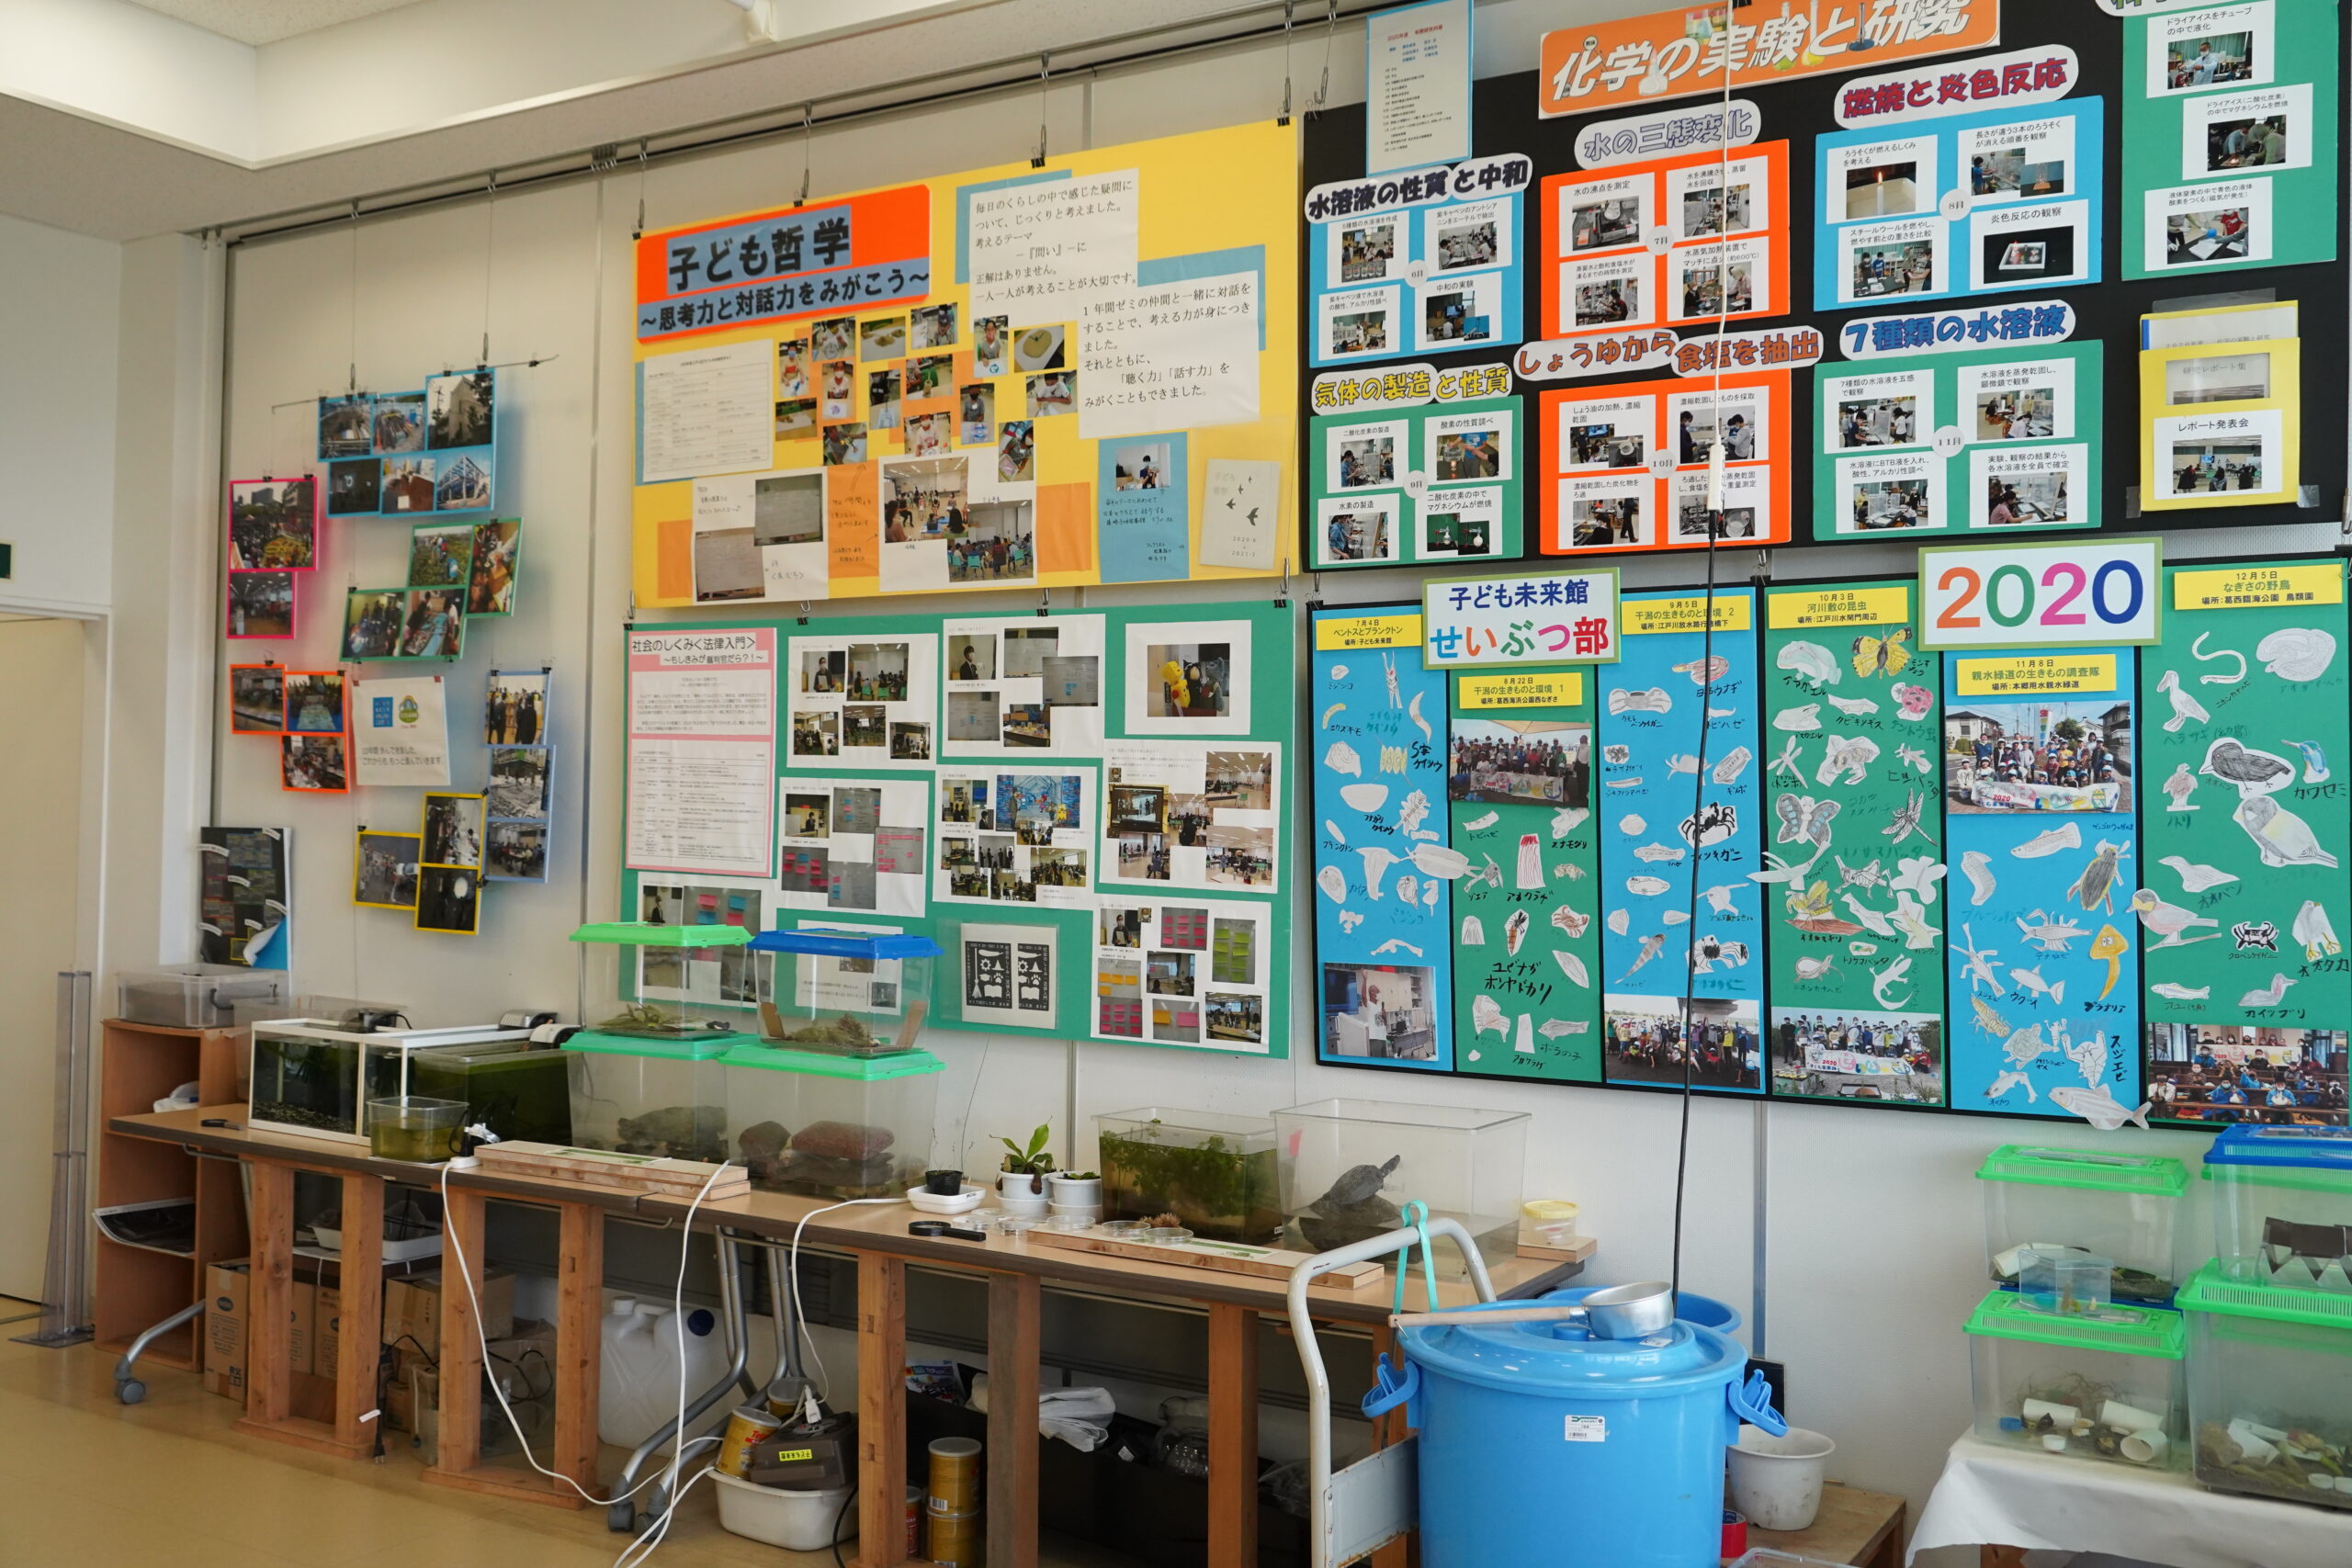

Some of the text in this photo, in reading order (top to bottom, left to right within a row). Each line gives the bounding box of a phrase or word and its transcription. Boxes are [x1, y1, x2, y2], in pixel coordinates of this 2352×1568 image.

[2166, 7, 2253, 26] ドライアイスをチューブ
[2166, 23, 2211, 37] の中で液化
[1552, 0, 1972, 101] 化学の実験と研究
[1842, 57, 2068, 119] 燃焼と炎色反応
[1584, 109, 1753, 162] 水の三態変化
[1844, 141, 1916, 157] ろうそくが燃えるしくみ
[1843, 156, 1871, 167] を考える
[1308, 159, 1530, 220] 水溶液の性質と中和
[1574, 180, 1631, 197] 水の沸点を測定
[975, 181, 1133, 214] 毎日のくらしの中で感じた疑問に
[975, 200, 1122, 230] ついて、じっくりと考えました。
[1991, 207, 2063, 224] 炎色反応の観察
[975, 231, 1034, 250] 考えるテーマ
[668, 216, 850, 291] 子ども哲学
[975, 266, 1057, 286] 正解はありません。
[975, 272, 1136, 301] 一人一人が考えることが大切です。
[1436, 280, 1475, 291] 中和の実験
[1083, 302, 1250, 335] することで、考える力が身につき
[1844, 304, 2067, 354] 7種類の水溶液
[1083, 339, 1119, 353] ました。
[1518, 330, 1819, 375] しょうゆから食塩を抽出
[1084, 355, 1150, 371] それとともに、
[1314, 367, 1510, 408] 気体の製造と性質
[1839, 374, 1915, 389] 7種類の水溶液を五感
[1980, 377, 2030, 389] 顕微鏡で観察
[1085, 384, 1207, 408] みがくこともできました。
[1842, 387, 1864, 397] で観察
[1440, 417, 1495, 430] 酸素の性質調べ
[2178, 417, 2249, 432] レポート発表会
[1343, 426, 1390, 437] 二酸化炭素の製造
[1427, 491, 1487, 502] 二酸化炭素の中で
[1339, 501, 1374, 512] 水素の製造
[2235, 570, 2278, 581] 12月5日
[1936, 558, 2143, 629] 2020
[2223, 580, 2290, 592] なぎさの野鳥
[1448, 579, 1589, 612] 子ども未来館
[1819, 592, 1854, 602] 10月3日
[1669, 600, 1698, 608] 9月5日
[1728, 607, 1735, 616] 2
[1807, 602, 1867, 613] 河川敷の昆虫
[1356, 618, 1379, 627] 7月4日
[1333, 626, 1403, 637] ベントスとプランクトン
[1430, 615, 1609, 660] せいぶつ部
[1344, 637, 1392, 646] 場所:子ども未来館
[2016, 659, 2054, 668] 11月8日
[1503, 676, 1533, 685] 8月22日
[1972, 667, 2100, 681] 親水緑道の生きもの調査隊
[1474, 684, 1553, 695] 干潟の生きものと環境
[2294, 783, 2347, 800] カワセミ
[1492, 961, 1541, 976] ユビナガ
[2299, 958, 2350, 977] オオタカ
[1485, 976, 1553, 1006] ホンヤドカリ
[2084, 1001, 2126, 1013] プラナリア
[2245, 1009, 2306, 1019] カイツブリ
[2110, 1034, 2129, 1083] スジエビ
